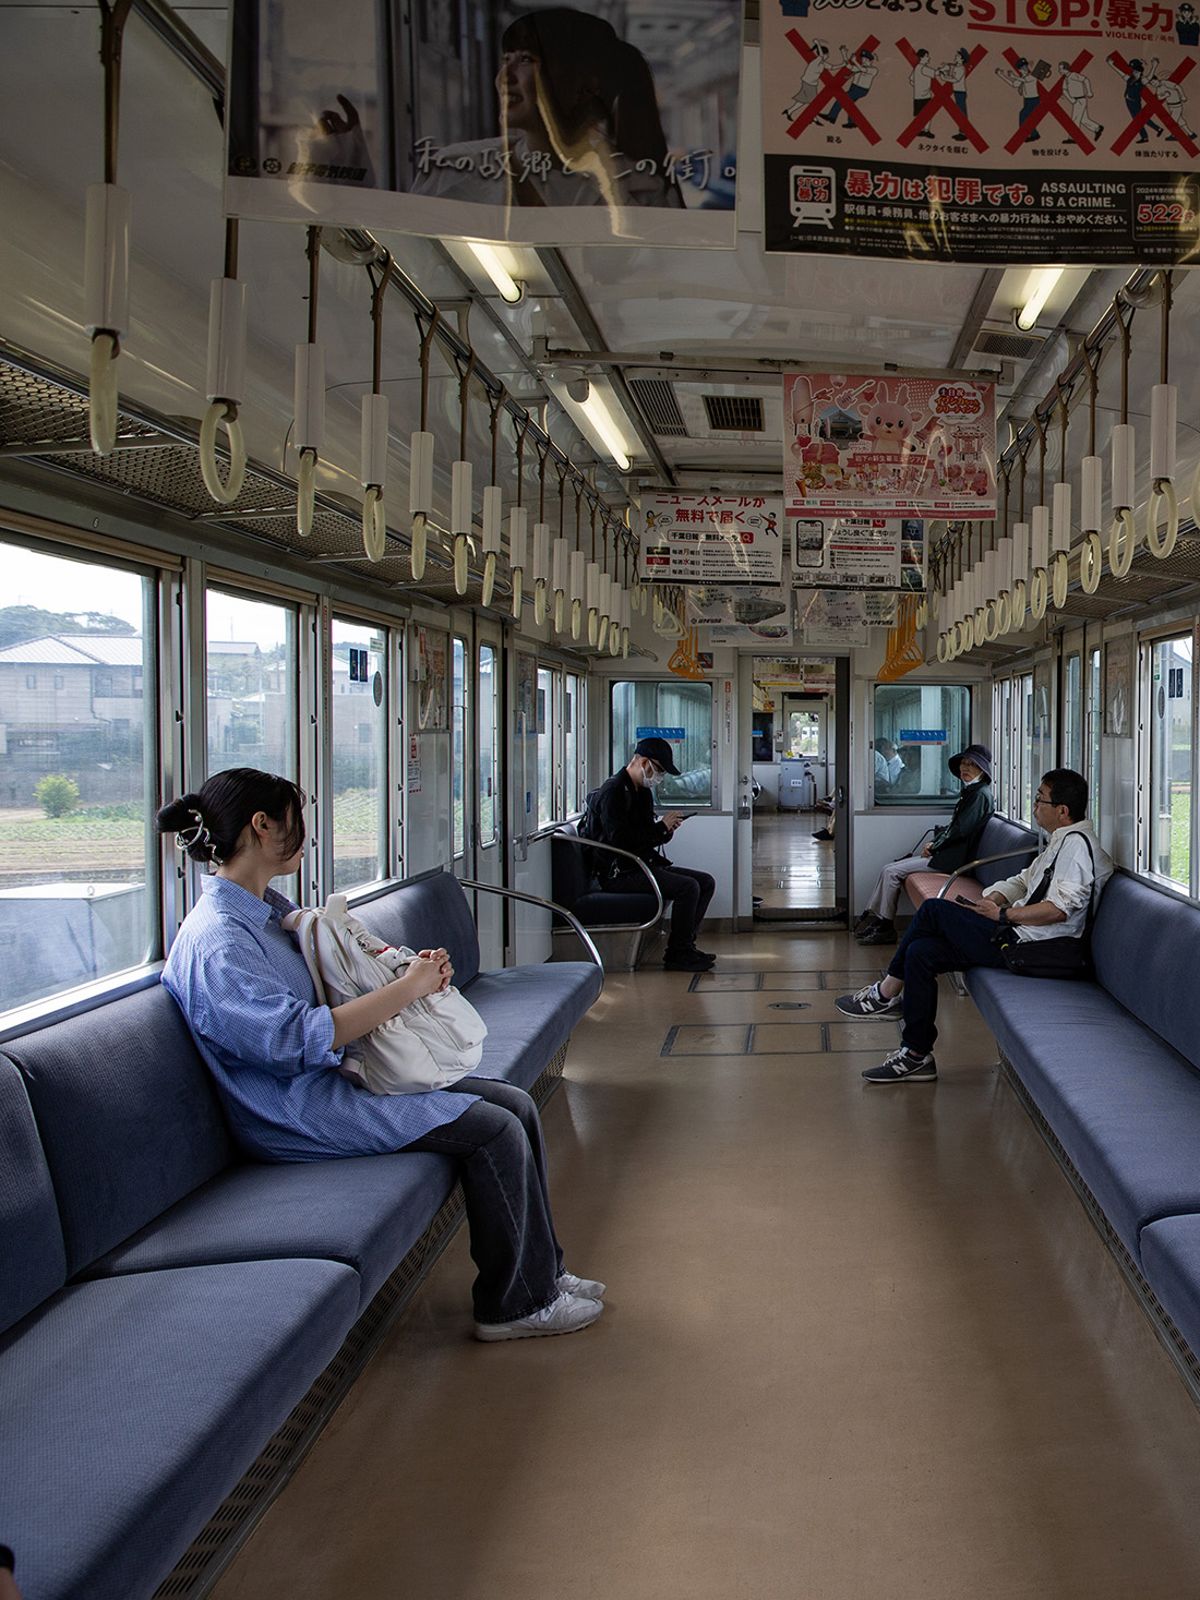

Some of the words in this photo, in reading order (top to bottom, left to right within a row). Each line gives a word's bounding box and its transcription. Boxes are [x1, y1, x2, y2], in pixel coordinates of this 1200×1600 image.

[1106, 0, 1174, 32] 暴力
[1105, 31, 1153, 41] VIOLENCE
[1032, 148, 1069, 157] 物を投げる
[797, 177, 829, 187] STOP
[846, 168, 1035, 206] 暴力は犯罪です。
[797, 187, 829, 202] 暴力
[1040, 183, 1127, 195] ASSAULTING
[1041, 196, 1054, 207] IS
[1056, 197, 1068, 207] A
[1069, 197, 1116, 208] CRIME.
[675, 509, 745, 524] 無料で届く
[860, 1001, 875, 1012] N
[892, 1062, 909, 1075] N
